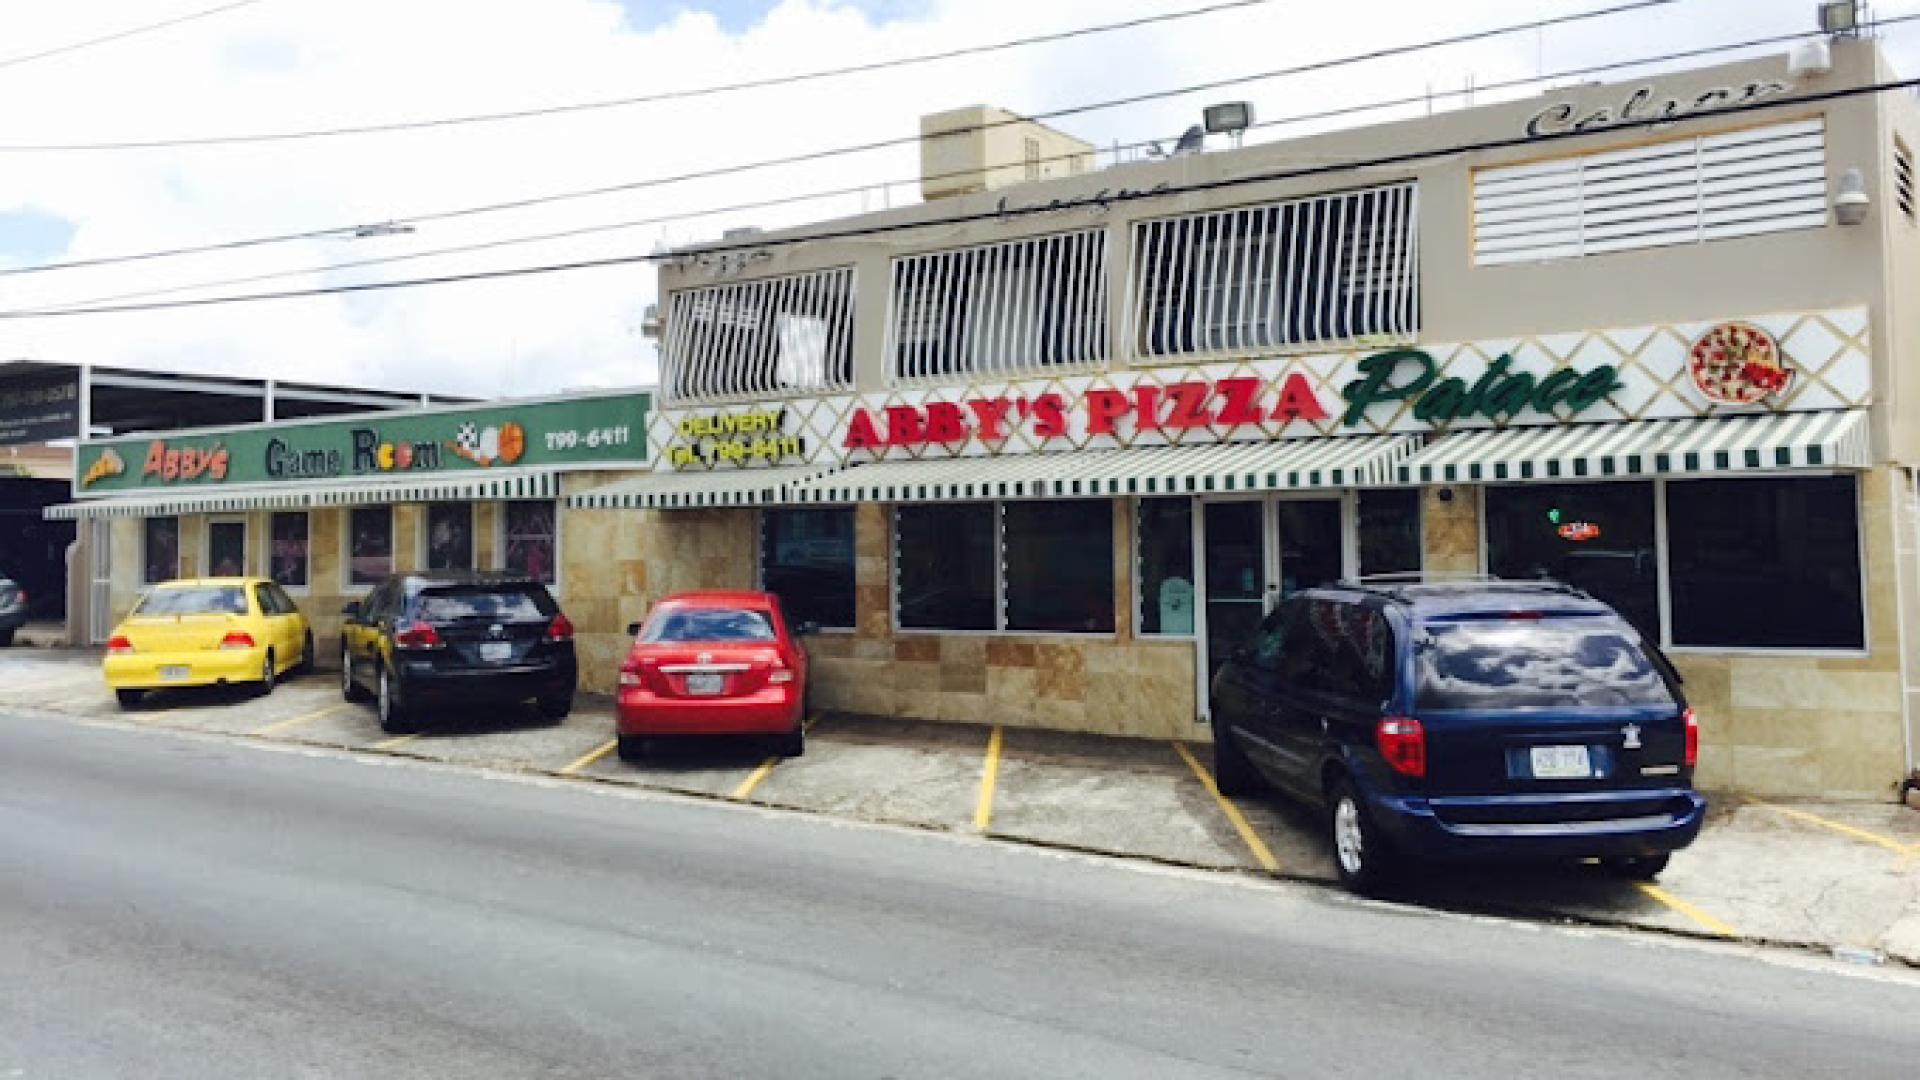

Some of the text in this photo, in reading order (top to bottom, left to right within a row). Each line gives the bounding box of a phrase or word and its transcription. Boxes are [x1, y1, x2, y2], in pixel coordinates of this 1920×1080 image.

[842, 348, 1626, 448] ABBY'S PIZZA Palace
[679, 408, 783, 438] DELIVERY
[265, 438, 343, 478] Game
